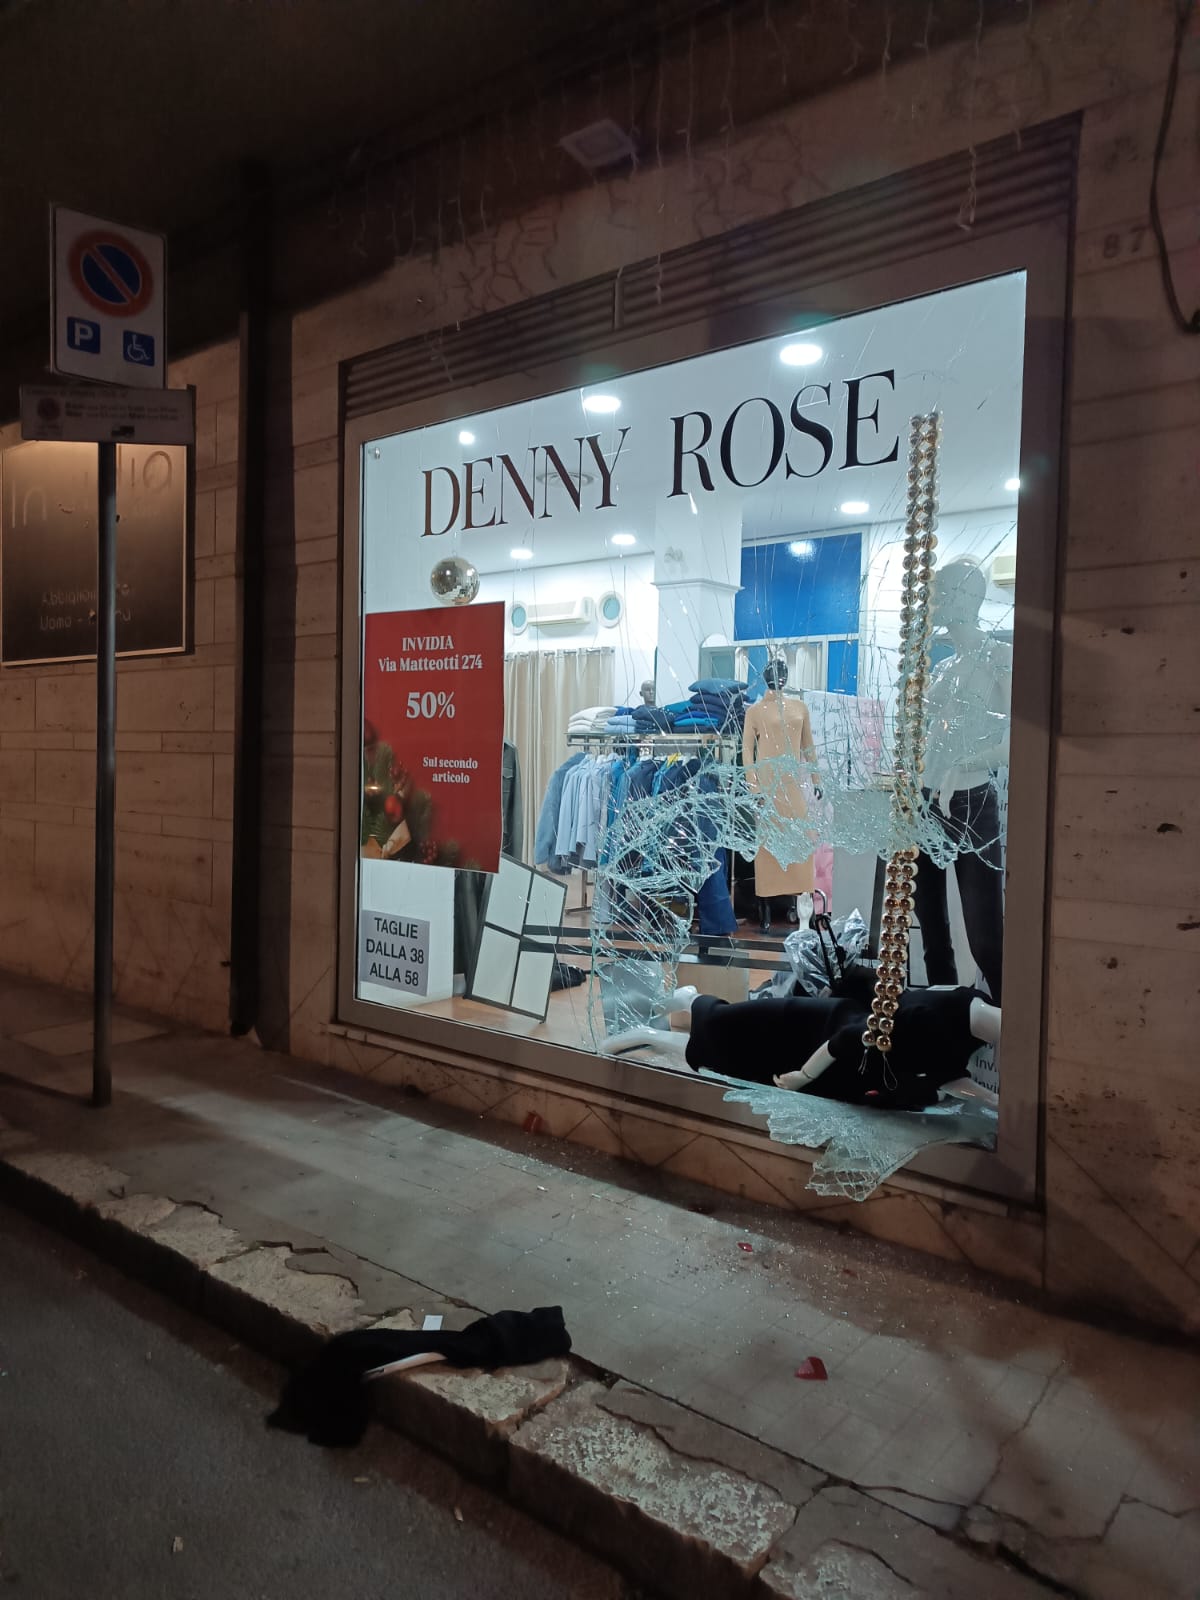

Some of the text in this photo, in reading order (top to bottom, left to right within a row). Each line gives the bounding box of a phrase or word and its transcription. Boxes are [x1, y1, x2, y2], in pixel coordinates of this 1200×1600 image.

[74, 322, 94, 346] P
[420, 369, 900, 538] DENNY ROSE
[402, 635, 455, 652] INVIDIA
[378, 654, 483, 672] Via Matteotti 274
[406, 691, 456, 719] 50%
[422, 756, 479, 769] Sul secondo
[432, 771, 470, 783] articolo
[374, 917, 418, 939] TAGLIE
[366, 938, 424, 964] DALLA 38
[369, 962, 419, 986] ALLA 58
